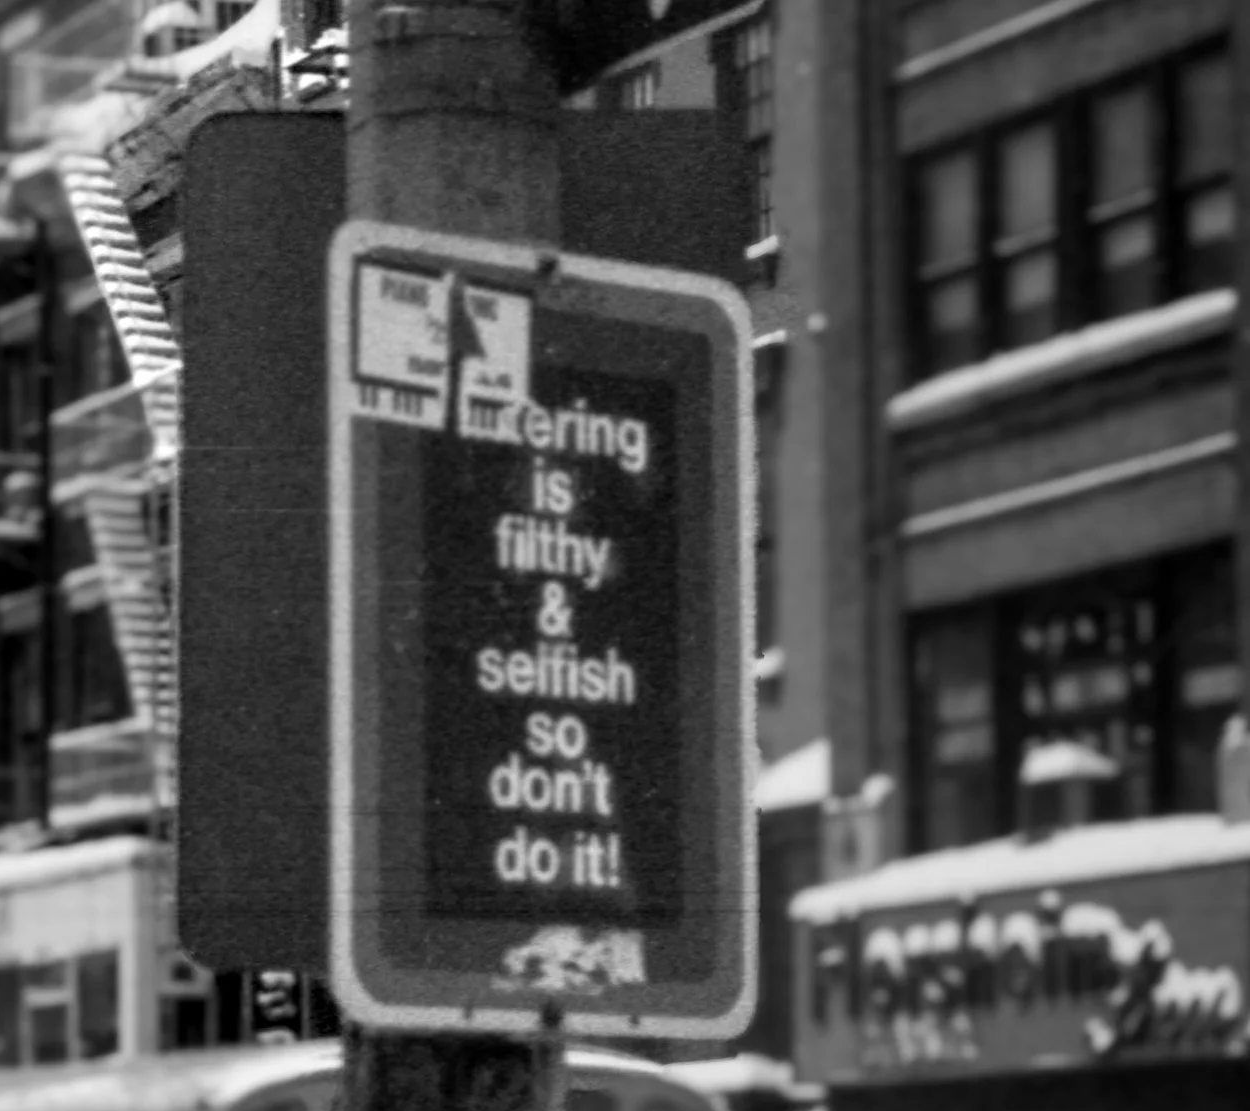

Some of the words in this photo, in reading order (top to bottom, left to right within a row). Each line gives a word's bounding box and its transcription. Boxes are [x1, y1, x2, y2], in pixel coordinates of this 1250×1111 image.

[532, 456, 575, 515] is
[495, 513, 612, 591] filthy
[536, 579, 573, 639] &
[476, 642, 636, 705] selfish
[526, 711, 588, 760] so
[488, 753, 614, 817] don't
[494, 826, 561, 884] do
[571, 831, 623, 889] it!
